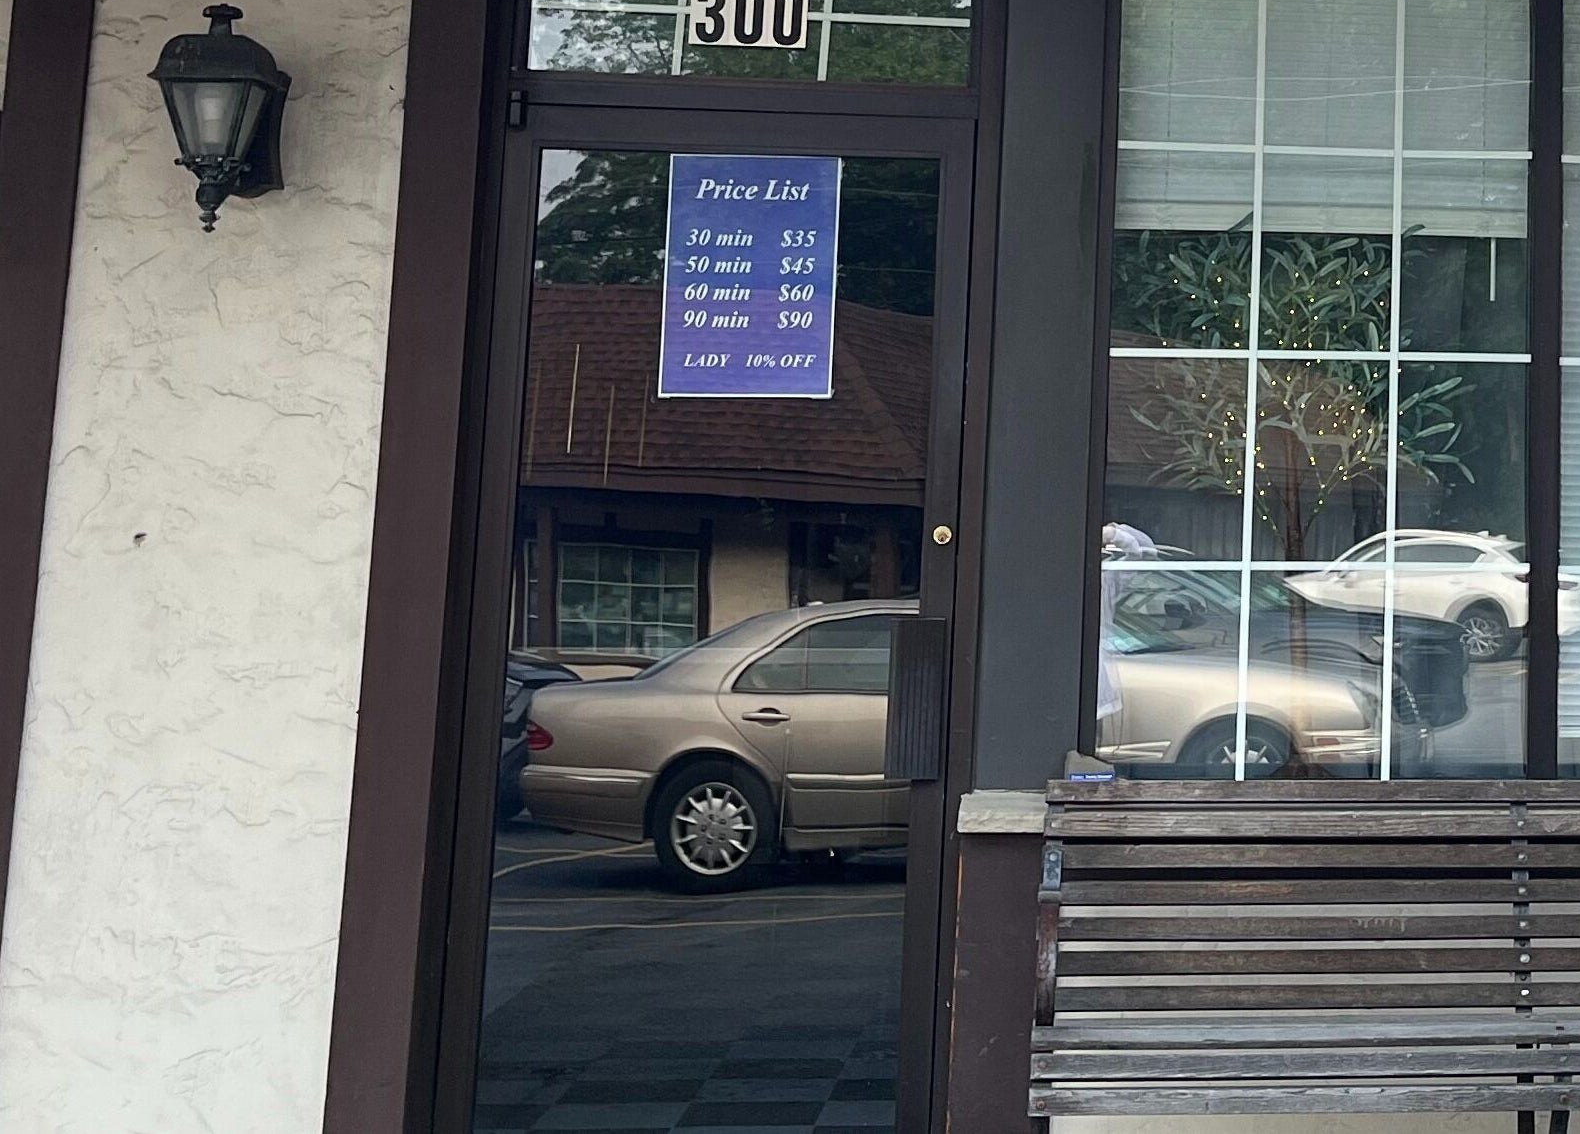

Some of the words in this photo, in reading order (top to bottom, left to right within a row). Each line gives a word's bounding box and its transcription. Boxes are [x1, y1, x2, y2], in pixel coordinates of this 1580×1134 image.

[694, 177, 759, 201] Price
[762, 179, 811, 202] List
[685, 228, 712, 247] 30
[715, 229, 753, 247] min
[780, 229, 817, 248] $35
[684, 255, 710, 274] 50
[714, 256, 752, 275] min
[779, 256, 816, 276] $45
[683, 283, 709, 301] 60
[712, 283, 751, 301] min
[778, 284, 815, 303] $60
[682, 310, 707, 329] 90
[711, 310, 750, 329] min
[777, 311, 814, 330] $90
[683, 353, 731, 368] LADY
[745, 354, 776, 368] 10%
[779, 353, 817, 368] OFF
